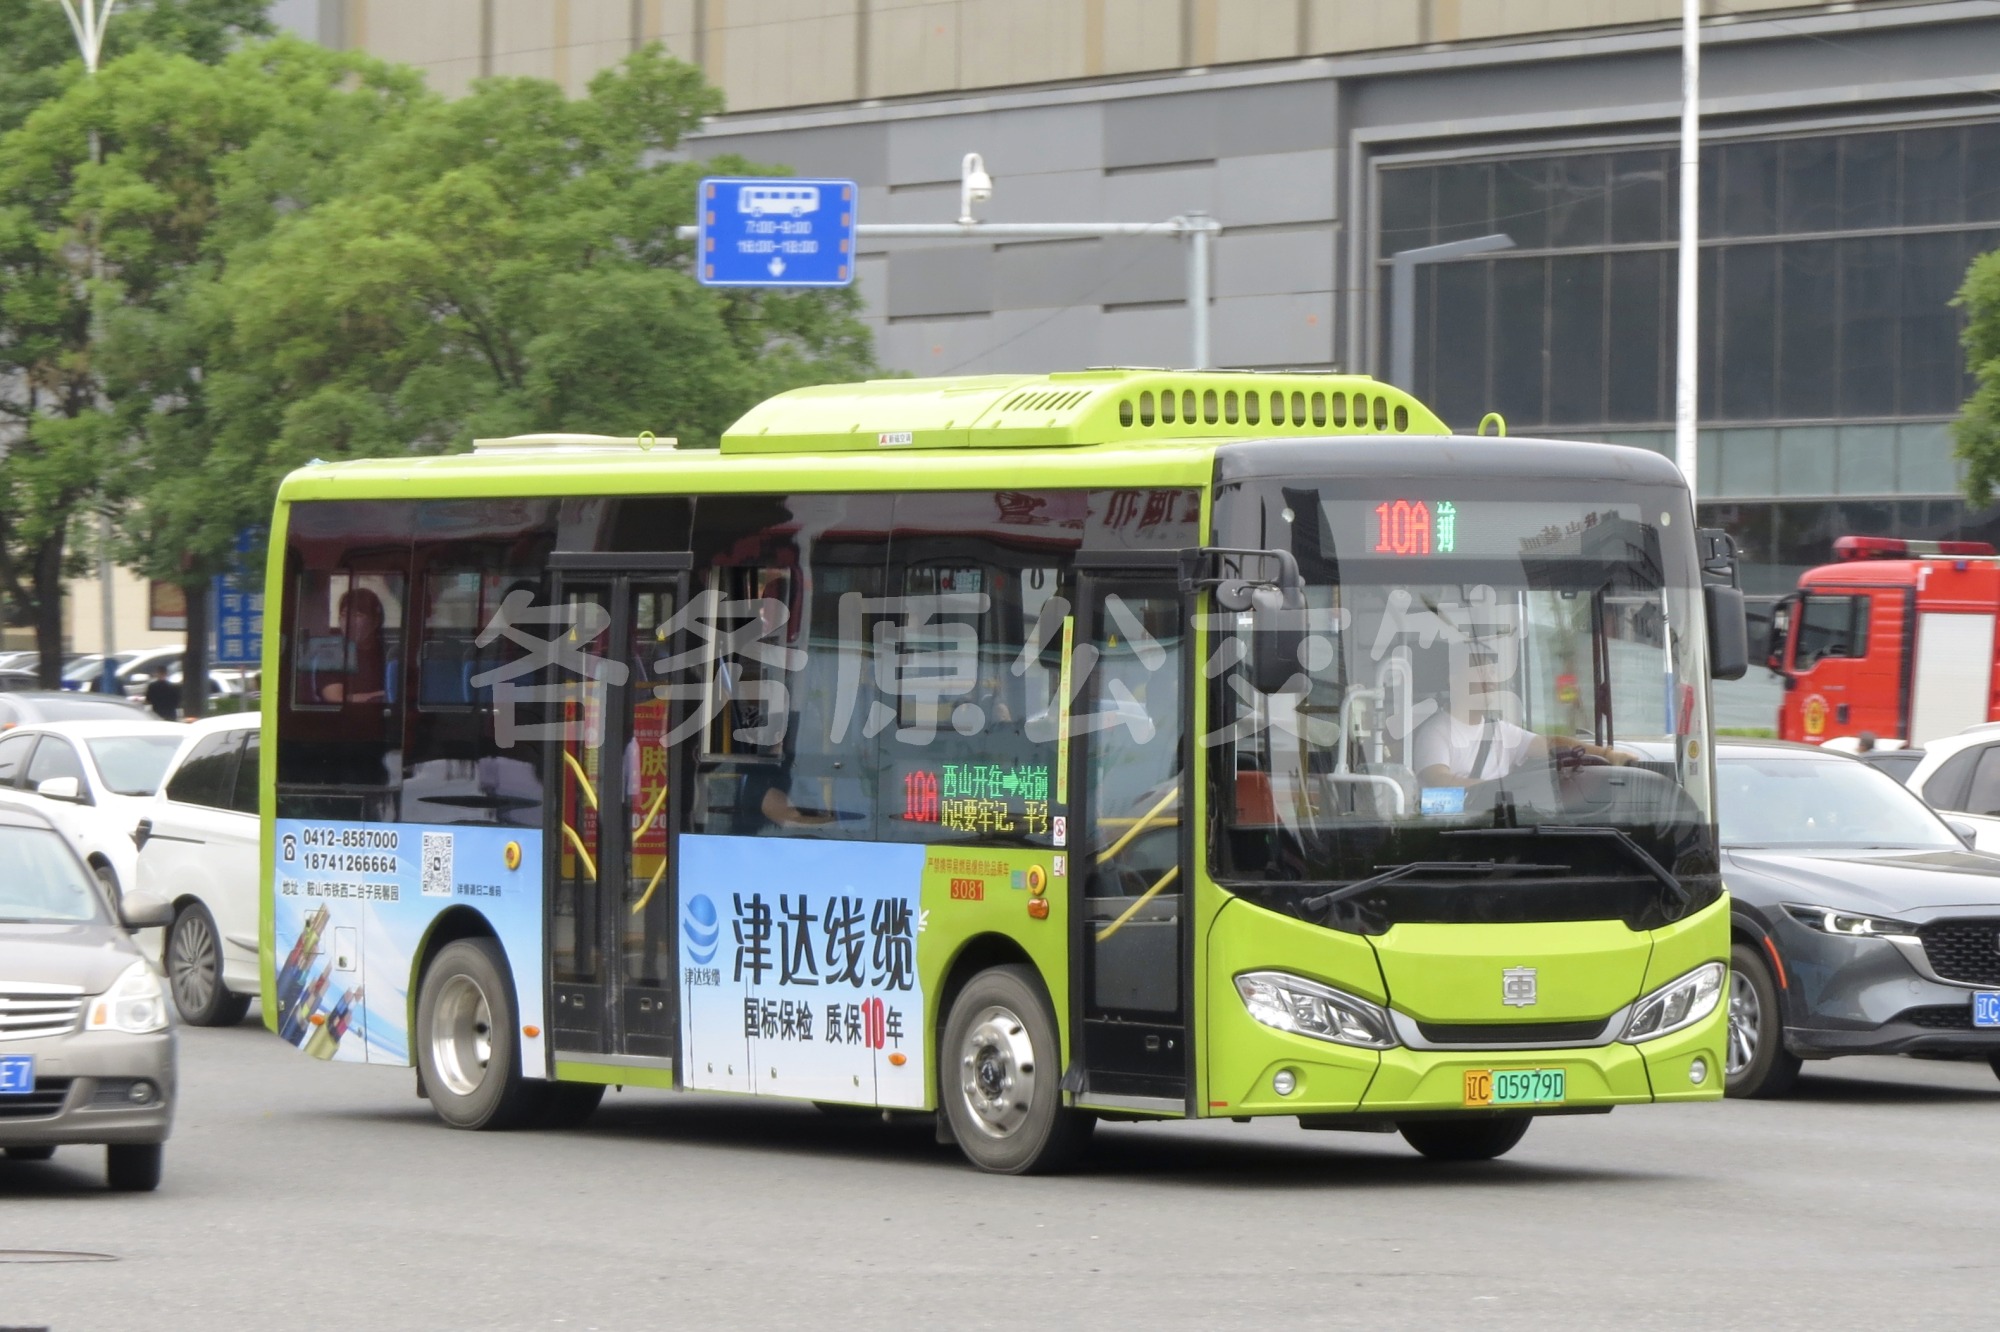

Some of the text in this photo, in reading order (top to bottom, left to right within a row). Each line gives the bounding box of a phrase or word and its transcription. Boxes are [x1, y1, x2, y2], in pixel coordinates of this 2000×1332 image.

[1375, 500, 1429, 554] 10A
[903, 771, 939, 823] 10A
[942, 764, 1004, 799] 西山开往
[303, 829, 398, 849] 0412-8587000
[303, 853, 397, 873] 18741266664
[952, 880, 983, 899] 3081
[731, 892, 915, 992] 津达线缆
[684, 967, 721, 987] 津达线缆
[744, 997, 904, 1050] 国标保检 质保10年
[1467, 1073, 1564, 1101] 辽C 05979D
